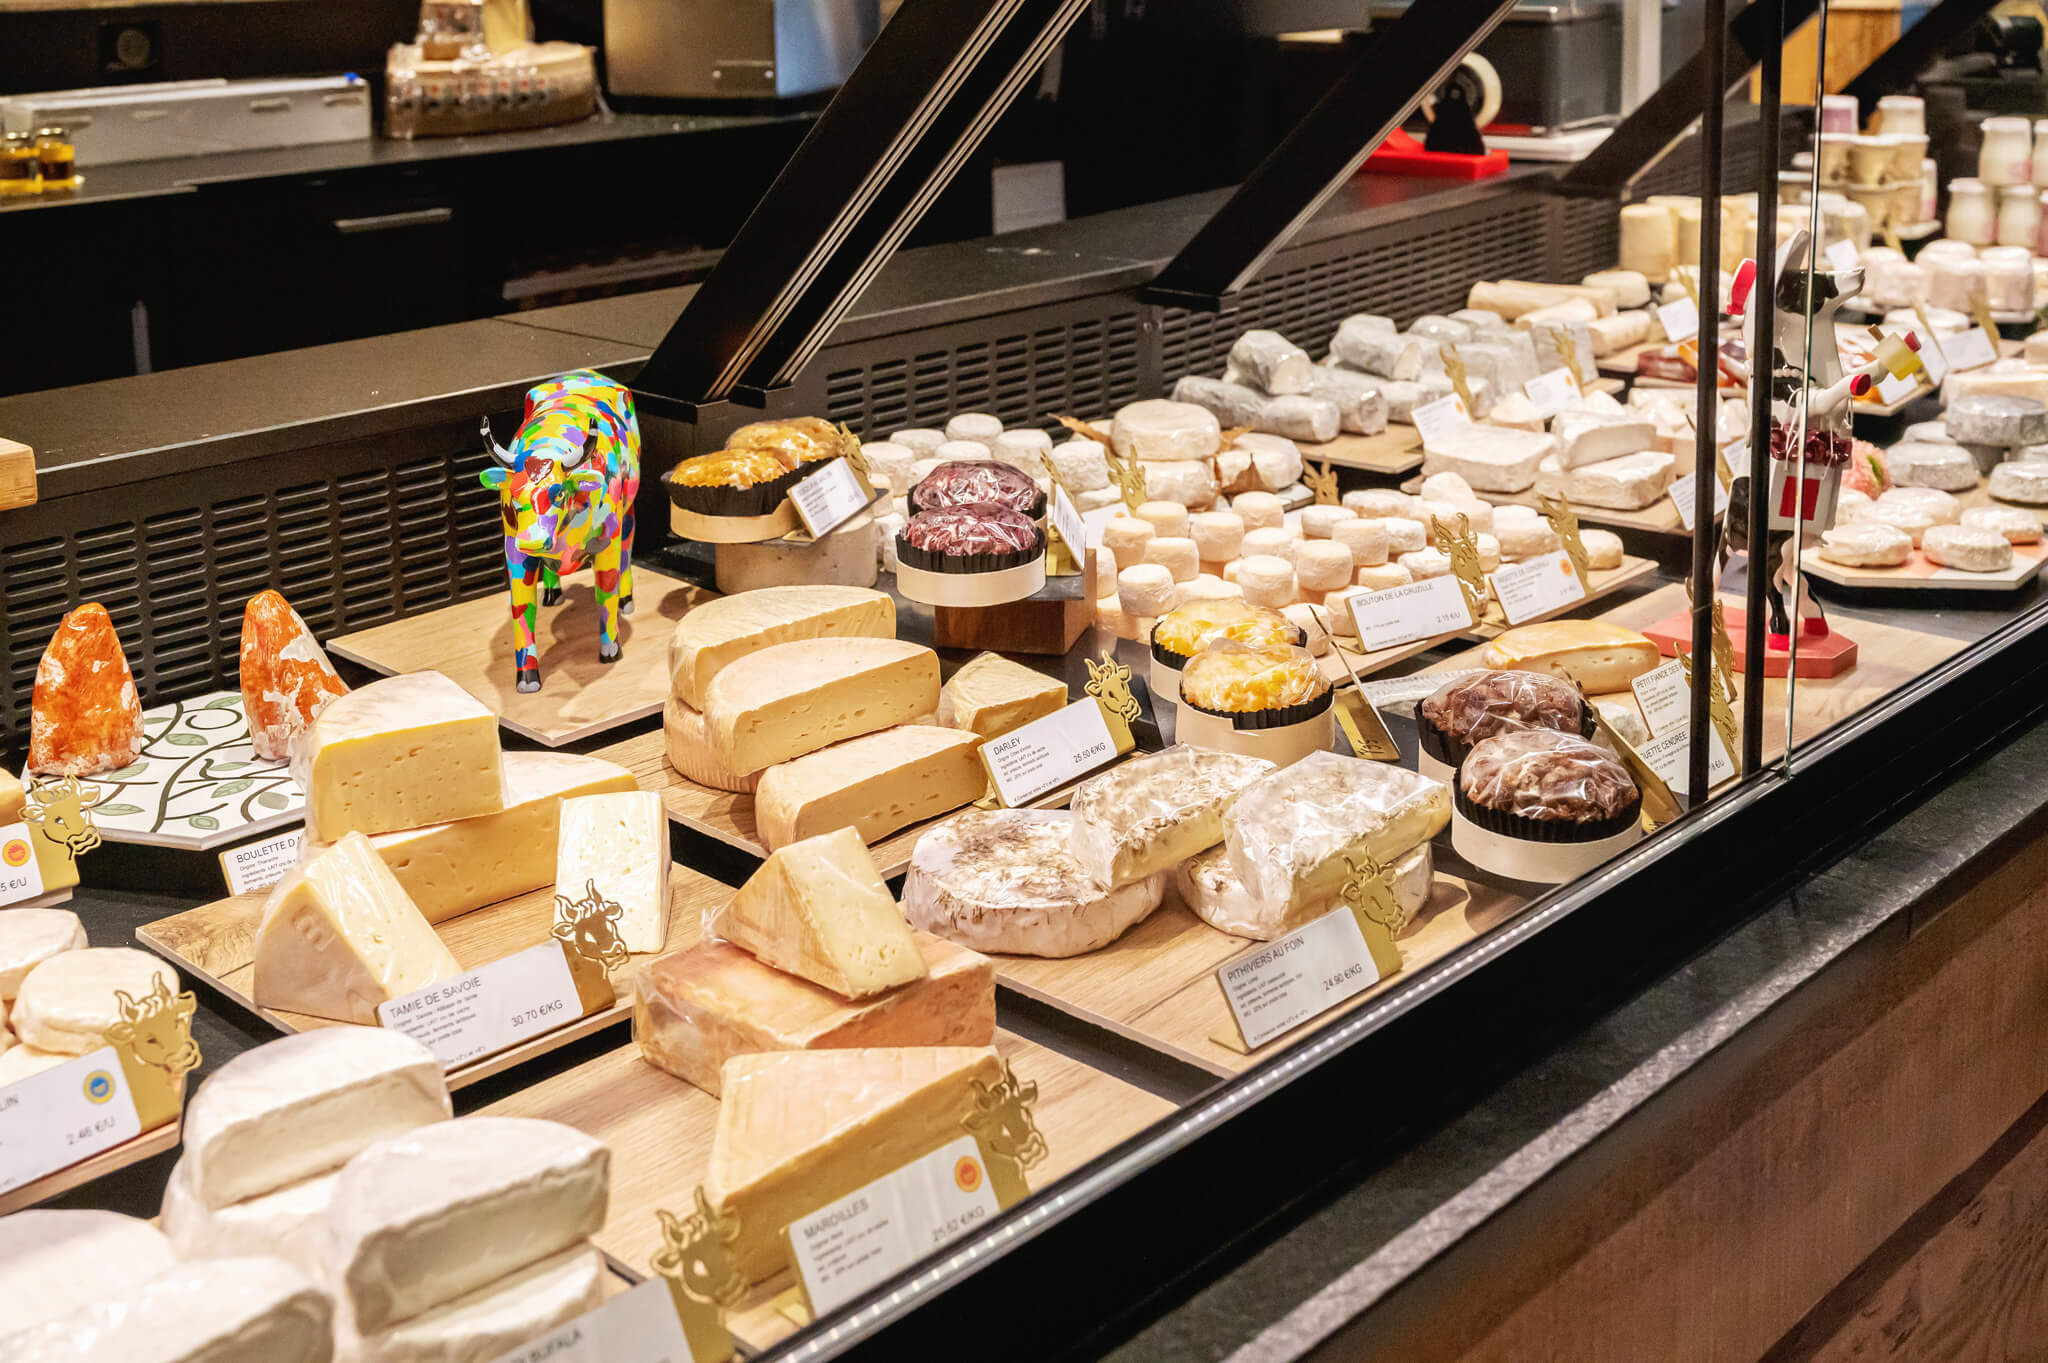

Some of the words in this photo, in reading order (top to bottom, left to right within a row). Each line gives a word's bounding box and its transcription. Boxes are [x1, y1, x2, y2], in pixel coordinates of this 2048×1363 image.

[1636, 675, 1651, 688] PETIT
[993, 736, 1021, 755] DARLEY
[236, 840, 287, 863] BOULETTE
[9, 876, 27, 889] €/U
[1227, 952, 1273, 982] PITHIVIERS
[1272, 946, 1284, 961] AU
[1284, 935, 1305, 953] FOIN
[389, 998, 423, 1018] TAMIE
[424, 991, 440, 1005] DE
[442, 976, 482, 998] SAVOIE
[539, 999, 563, 1016] €/KG
[804, 1198, 869, 1240] MAROILLES
